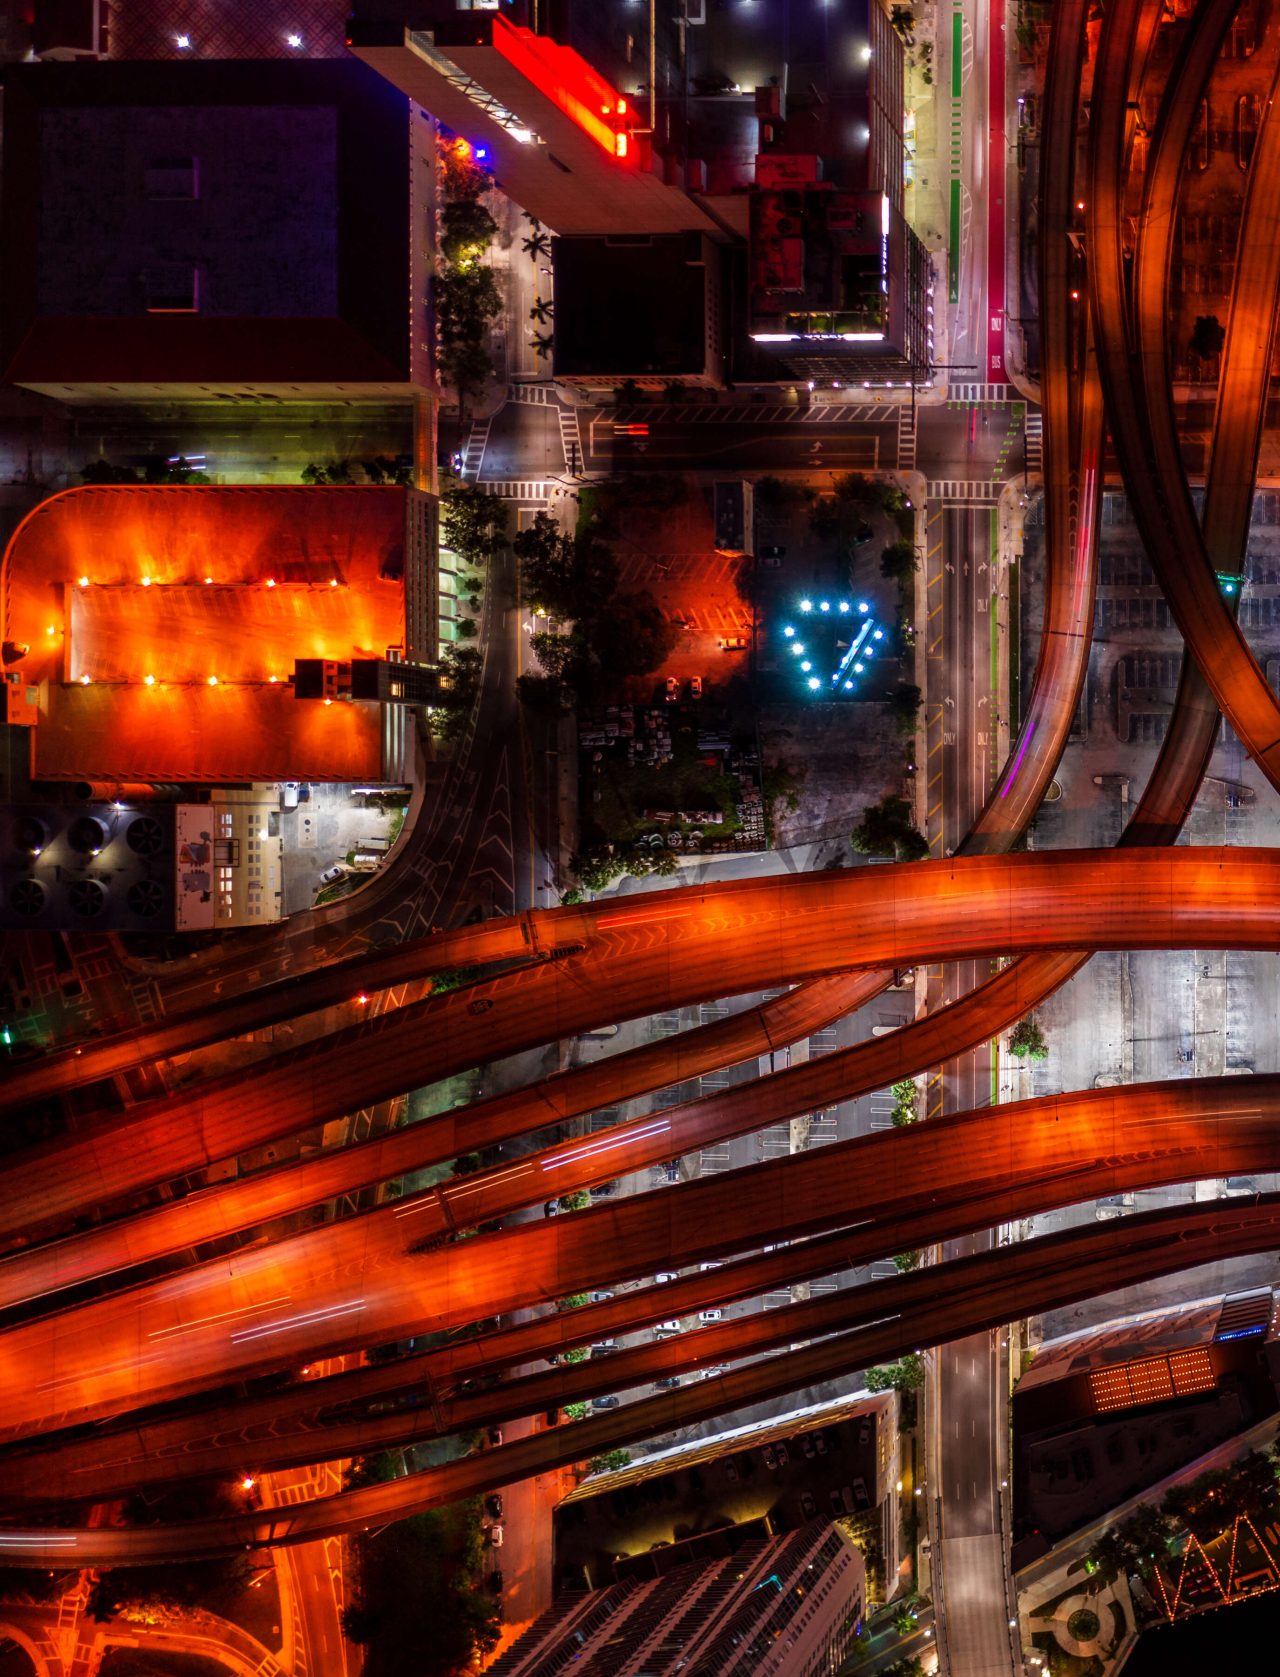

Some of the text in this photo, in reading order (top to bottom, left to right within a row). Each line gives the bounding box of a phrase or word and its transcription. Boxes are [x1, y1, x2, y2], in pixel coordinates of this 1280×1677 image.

[991, 317, 1001, 331] ONLY
[991, 355, 1001, 369] BUS
[977, 598, 988, 612] ONLY
[943, 732, 956, 745] ONLY
[977, 732, 989, 745] ONLY
